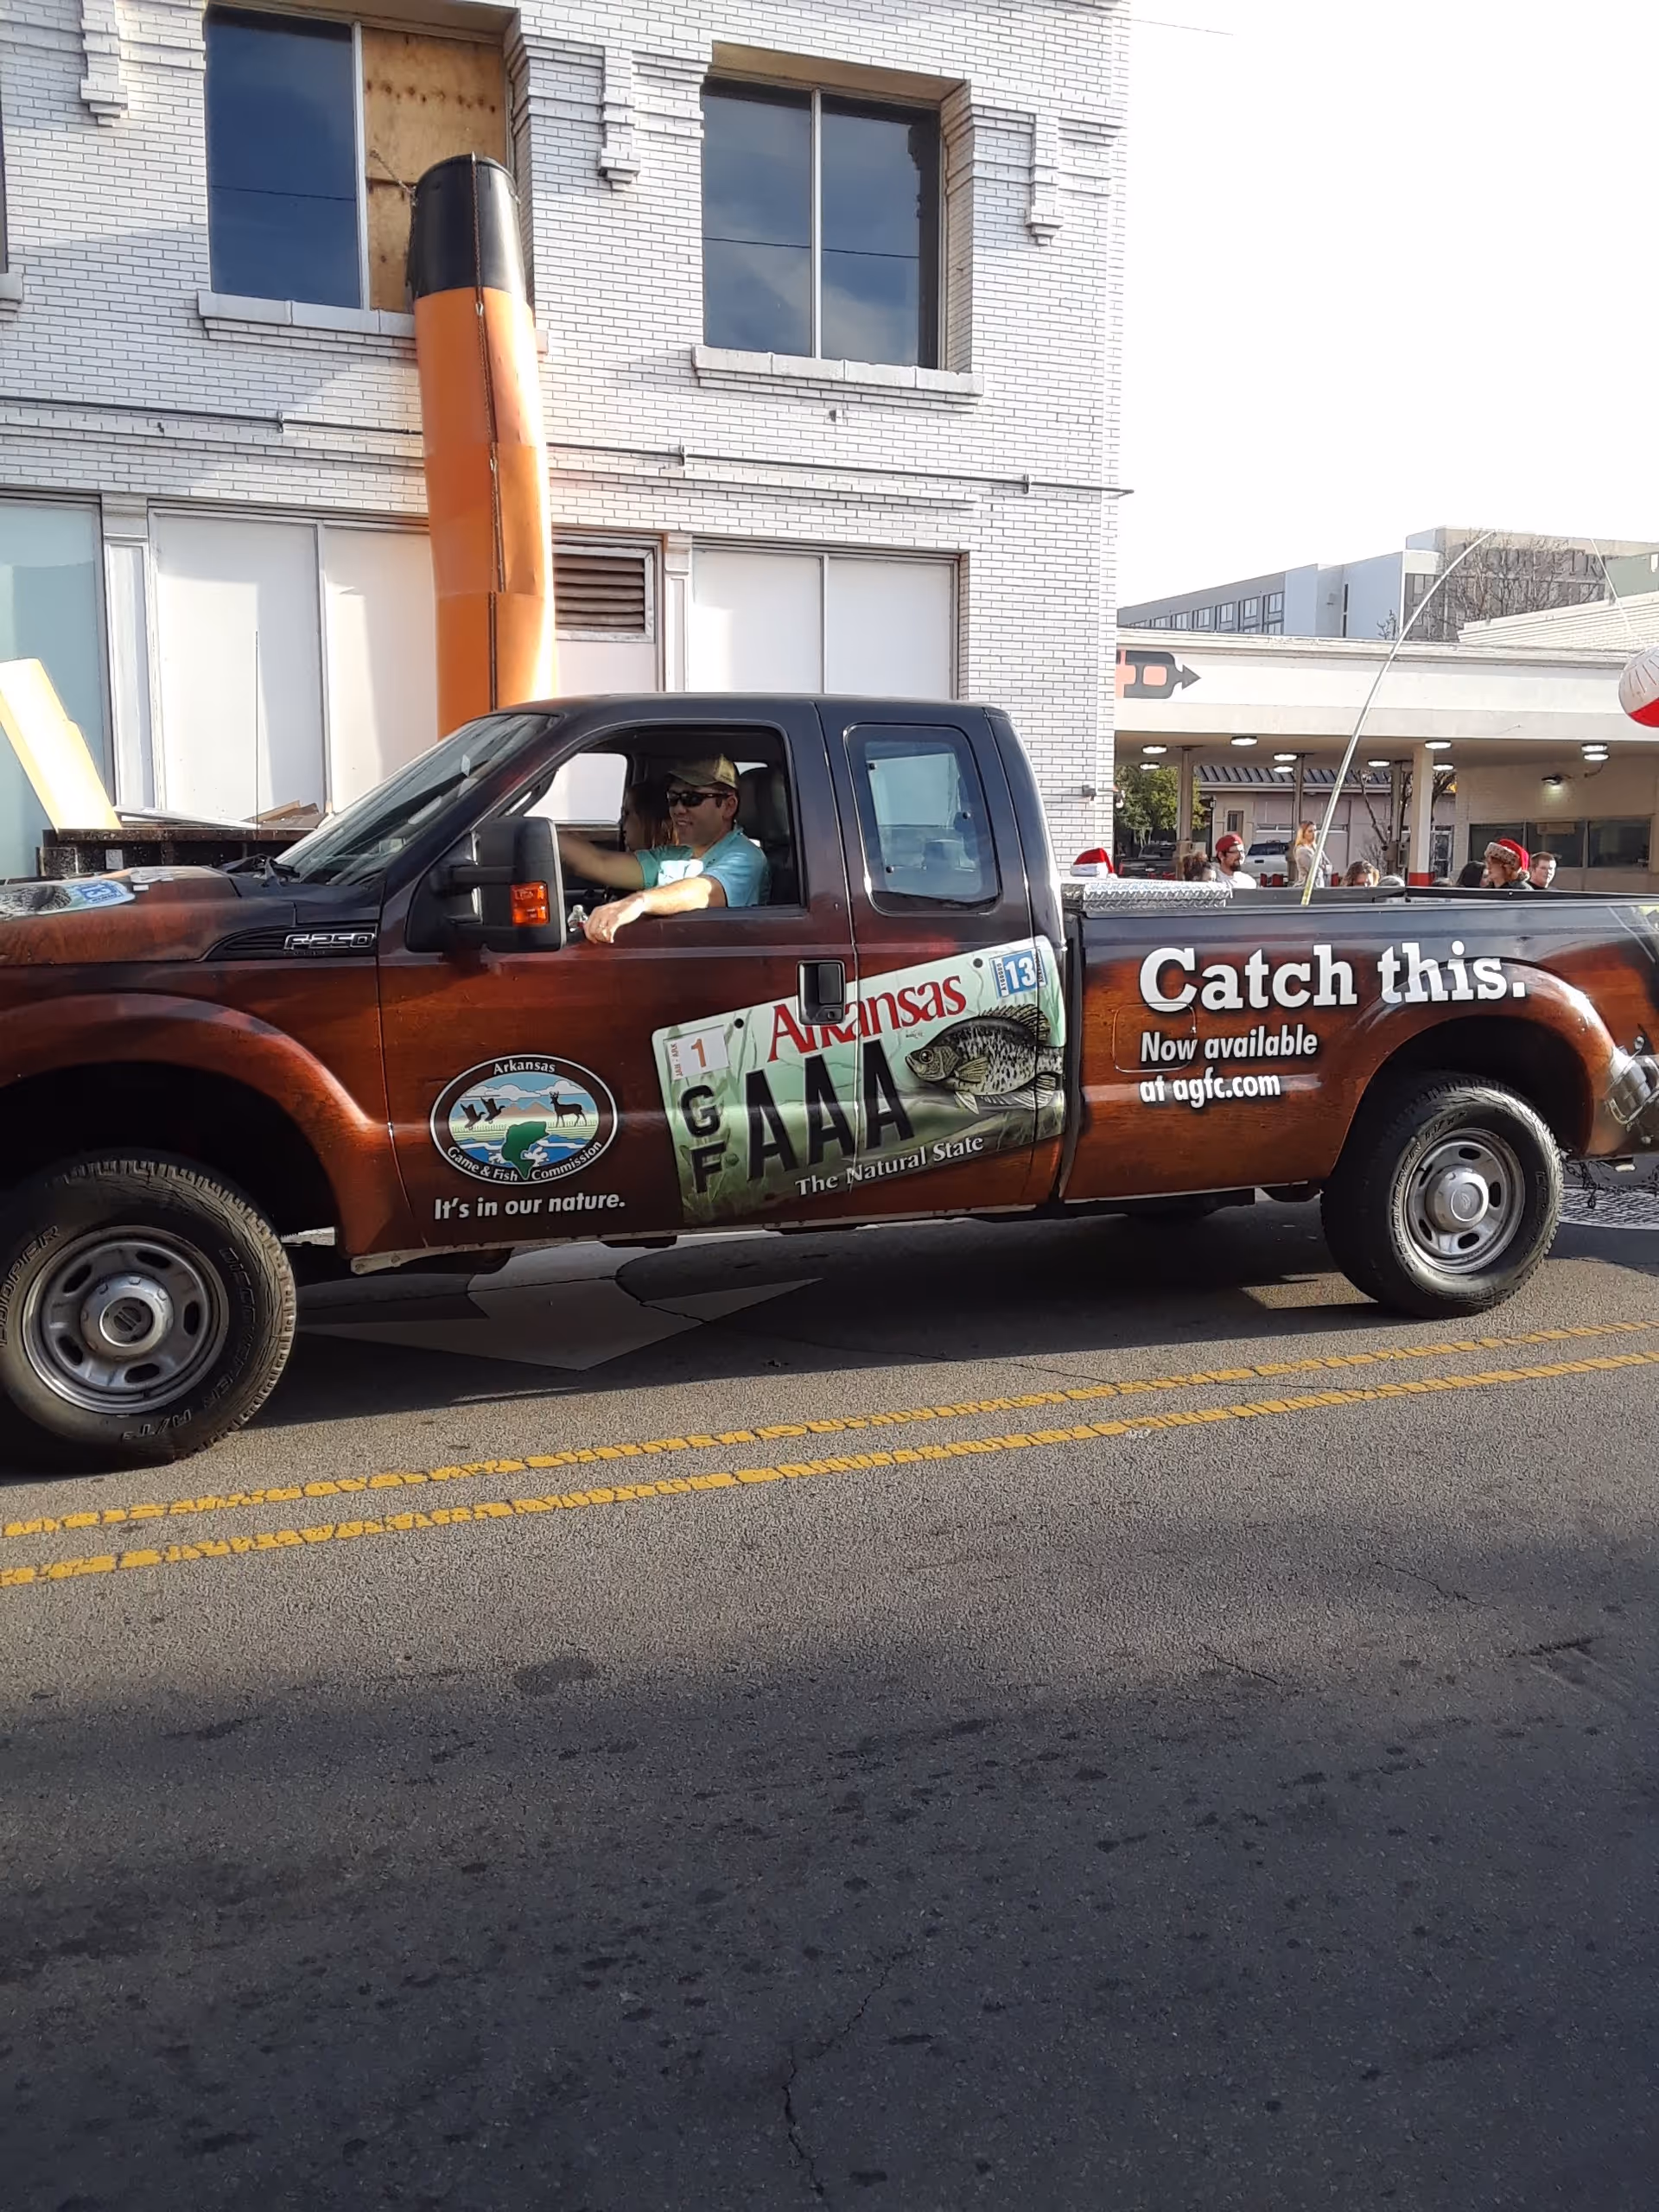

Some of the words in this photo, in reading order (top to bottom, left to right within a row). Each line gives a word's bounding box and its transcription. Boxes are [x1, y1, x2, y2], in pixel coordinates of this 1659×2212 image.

[283, 933, 375, 950] F-250
[1005, 957, 1035, 989] 13
[1140, 944, 1357, 1013] Catch
[1377, 940, 1526, 1003] this.
[1141, 1031, 1198, 1063] Now
[1205, 1023, 1318, 1059] available
[493, 1059, 556, 1075] Arkansas
[1140, 1072, 1165, 1103] at
[1173, 1067, 1281, 1109] agfc.com
[746, 1039, 913, 1181] AAA
[447, 1147, 480, 1173] Game
[480, 1168, 490, 1177] &
[493, 1169, 518, 1181] Fish
[531, 1141, 602, 1181] Commission
[795, 1174, 838, 1197] The
[852, 1150, 927, 1184] Natural
[932, 1136, 984, 1161] State
[435, 1198, 470, 1220] It's
[477, 1197, 496, 1217] in
[505, 1198, 542, 1215] our
[548, 1192, 626, 1212] nature.
